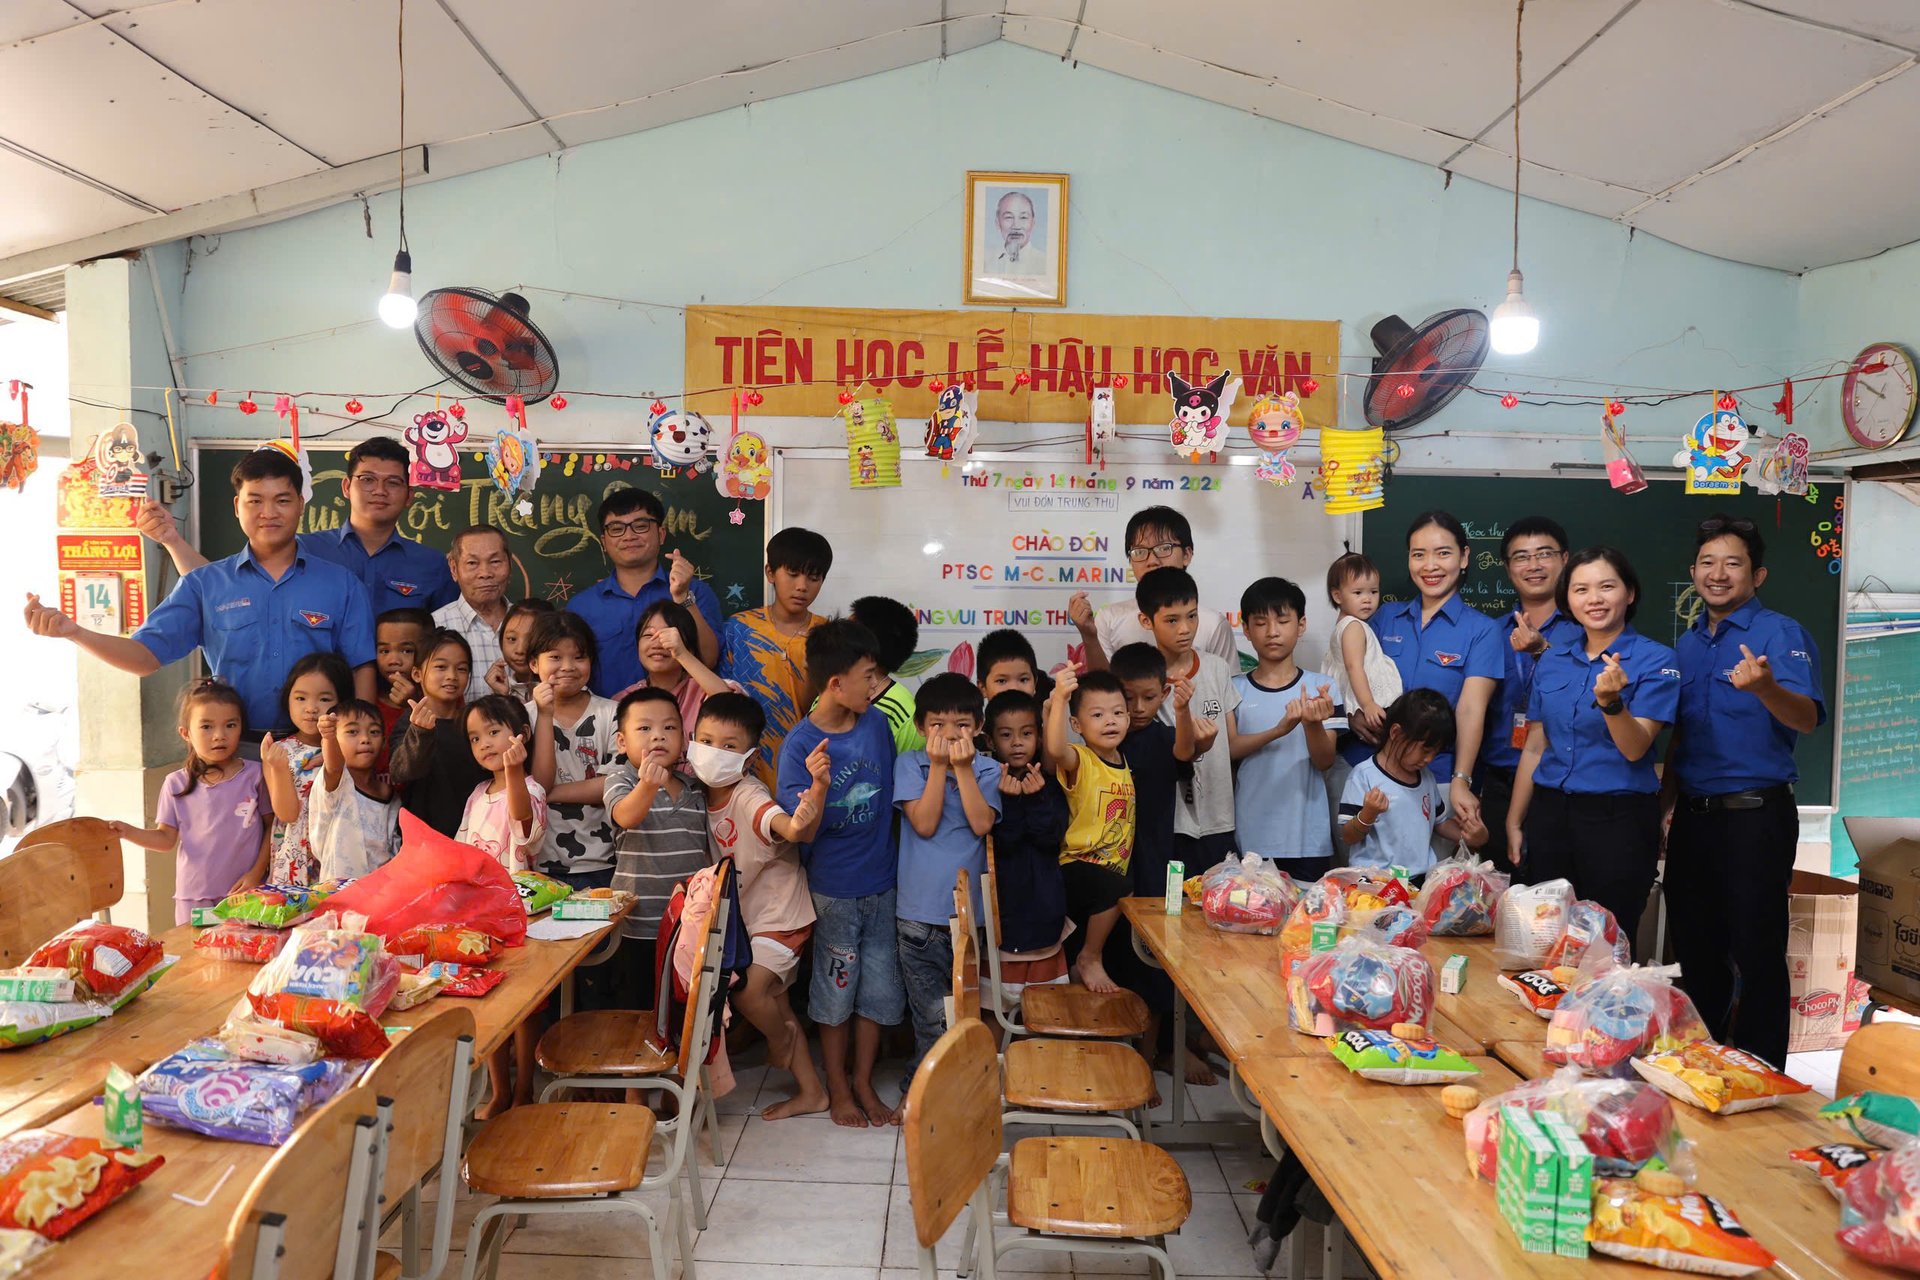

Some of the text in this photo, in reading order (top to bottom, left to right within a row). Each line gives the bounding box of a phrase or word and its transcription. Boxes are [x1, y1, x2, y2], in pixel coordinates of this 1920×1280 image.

[715, 328, 813, 385] TIÊN
[836, 338, 925, 394] HỌC
[1031, 337, 1112, 398] HẬU
[1239, 344, 1311, 398] VĂN
[962, 470, 1221, 491] Thứ 7 ngày 14 tháng 9 năm 2024
[1014, 497, 1031, 508] VUI
[1058, 497, 1091, 508] TRUNG
[1096, 497, 1115, 507] THU
[1012, 528, 1108, 551] CHÀO ĐÓN
[113, 544, 137, 561] LỢI
[943, 564, 993, 580] PTSC
[1059, 567, 1137, 583] MARINE
[85, 584, 111, 608] 14
[948, 609, 976, 625] VUI
[983, 609, 1042, 626] TRUNG
